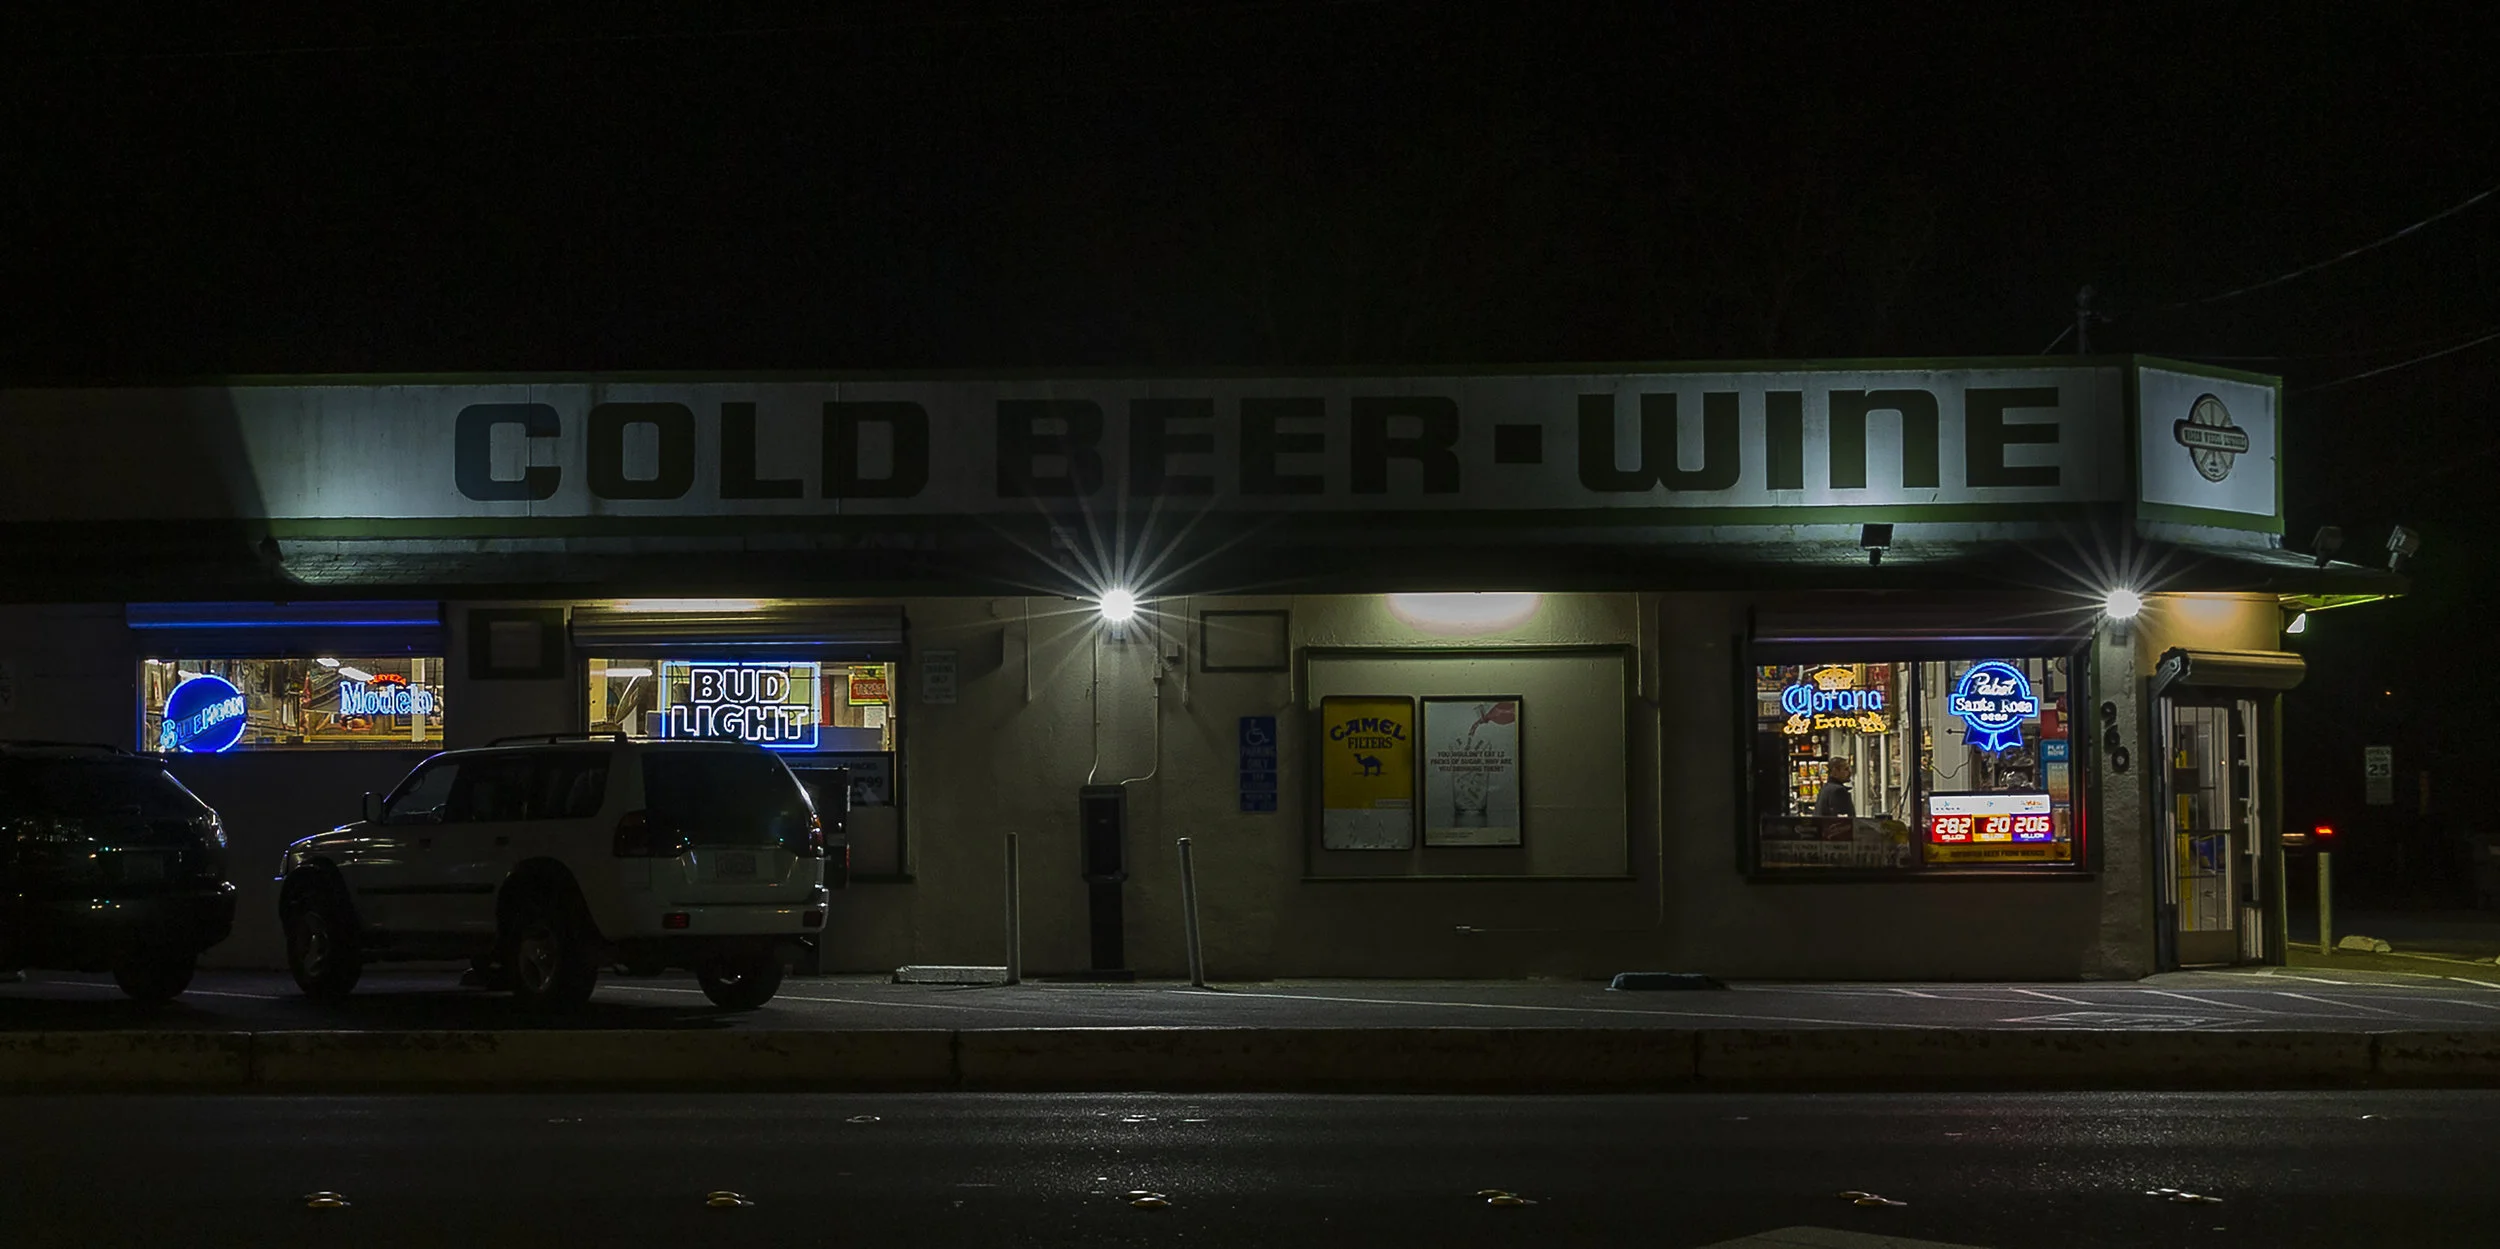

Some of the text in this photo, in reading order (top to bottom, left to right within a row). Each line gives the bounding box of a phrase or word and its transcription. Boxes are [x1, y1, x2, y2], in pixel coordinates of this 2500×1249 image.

[454, 400, 930, 501] COLD
[995, 394, 1460, 499] BEER
[690, 667, 790, 704] BUD
[1970, 672, 2018, 696] Pabst
[339, 681, 434, 715] Modelo
[1781, 683, 1883, 719] Corona
[1954, 697, 2034, 713] Santa Rosa
[201, 695, 245, 730] MOON
[670, 704, 810, 740] LIGHT
[1814, 713, 1858, 730] Extra
[1329, 717, 1407, 742] CAMEL
[1346, 736, 1394, 750] FILTERS
[2368, 763, 2389, 776] 25
[1935, 815, 2050, 834] 282 20 206
